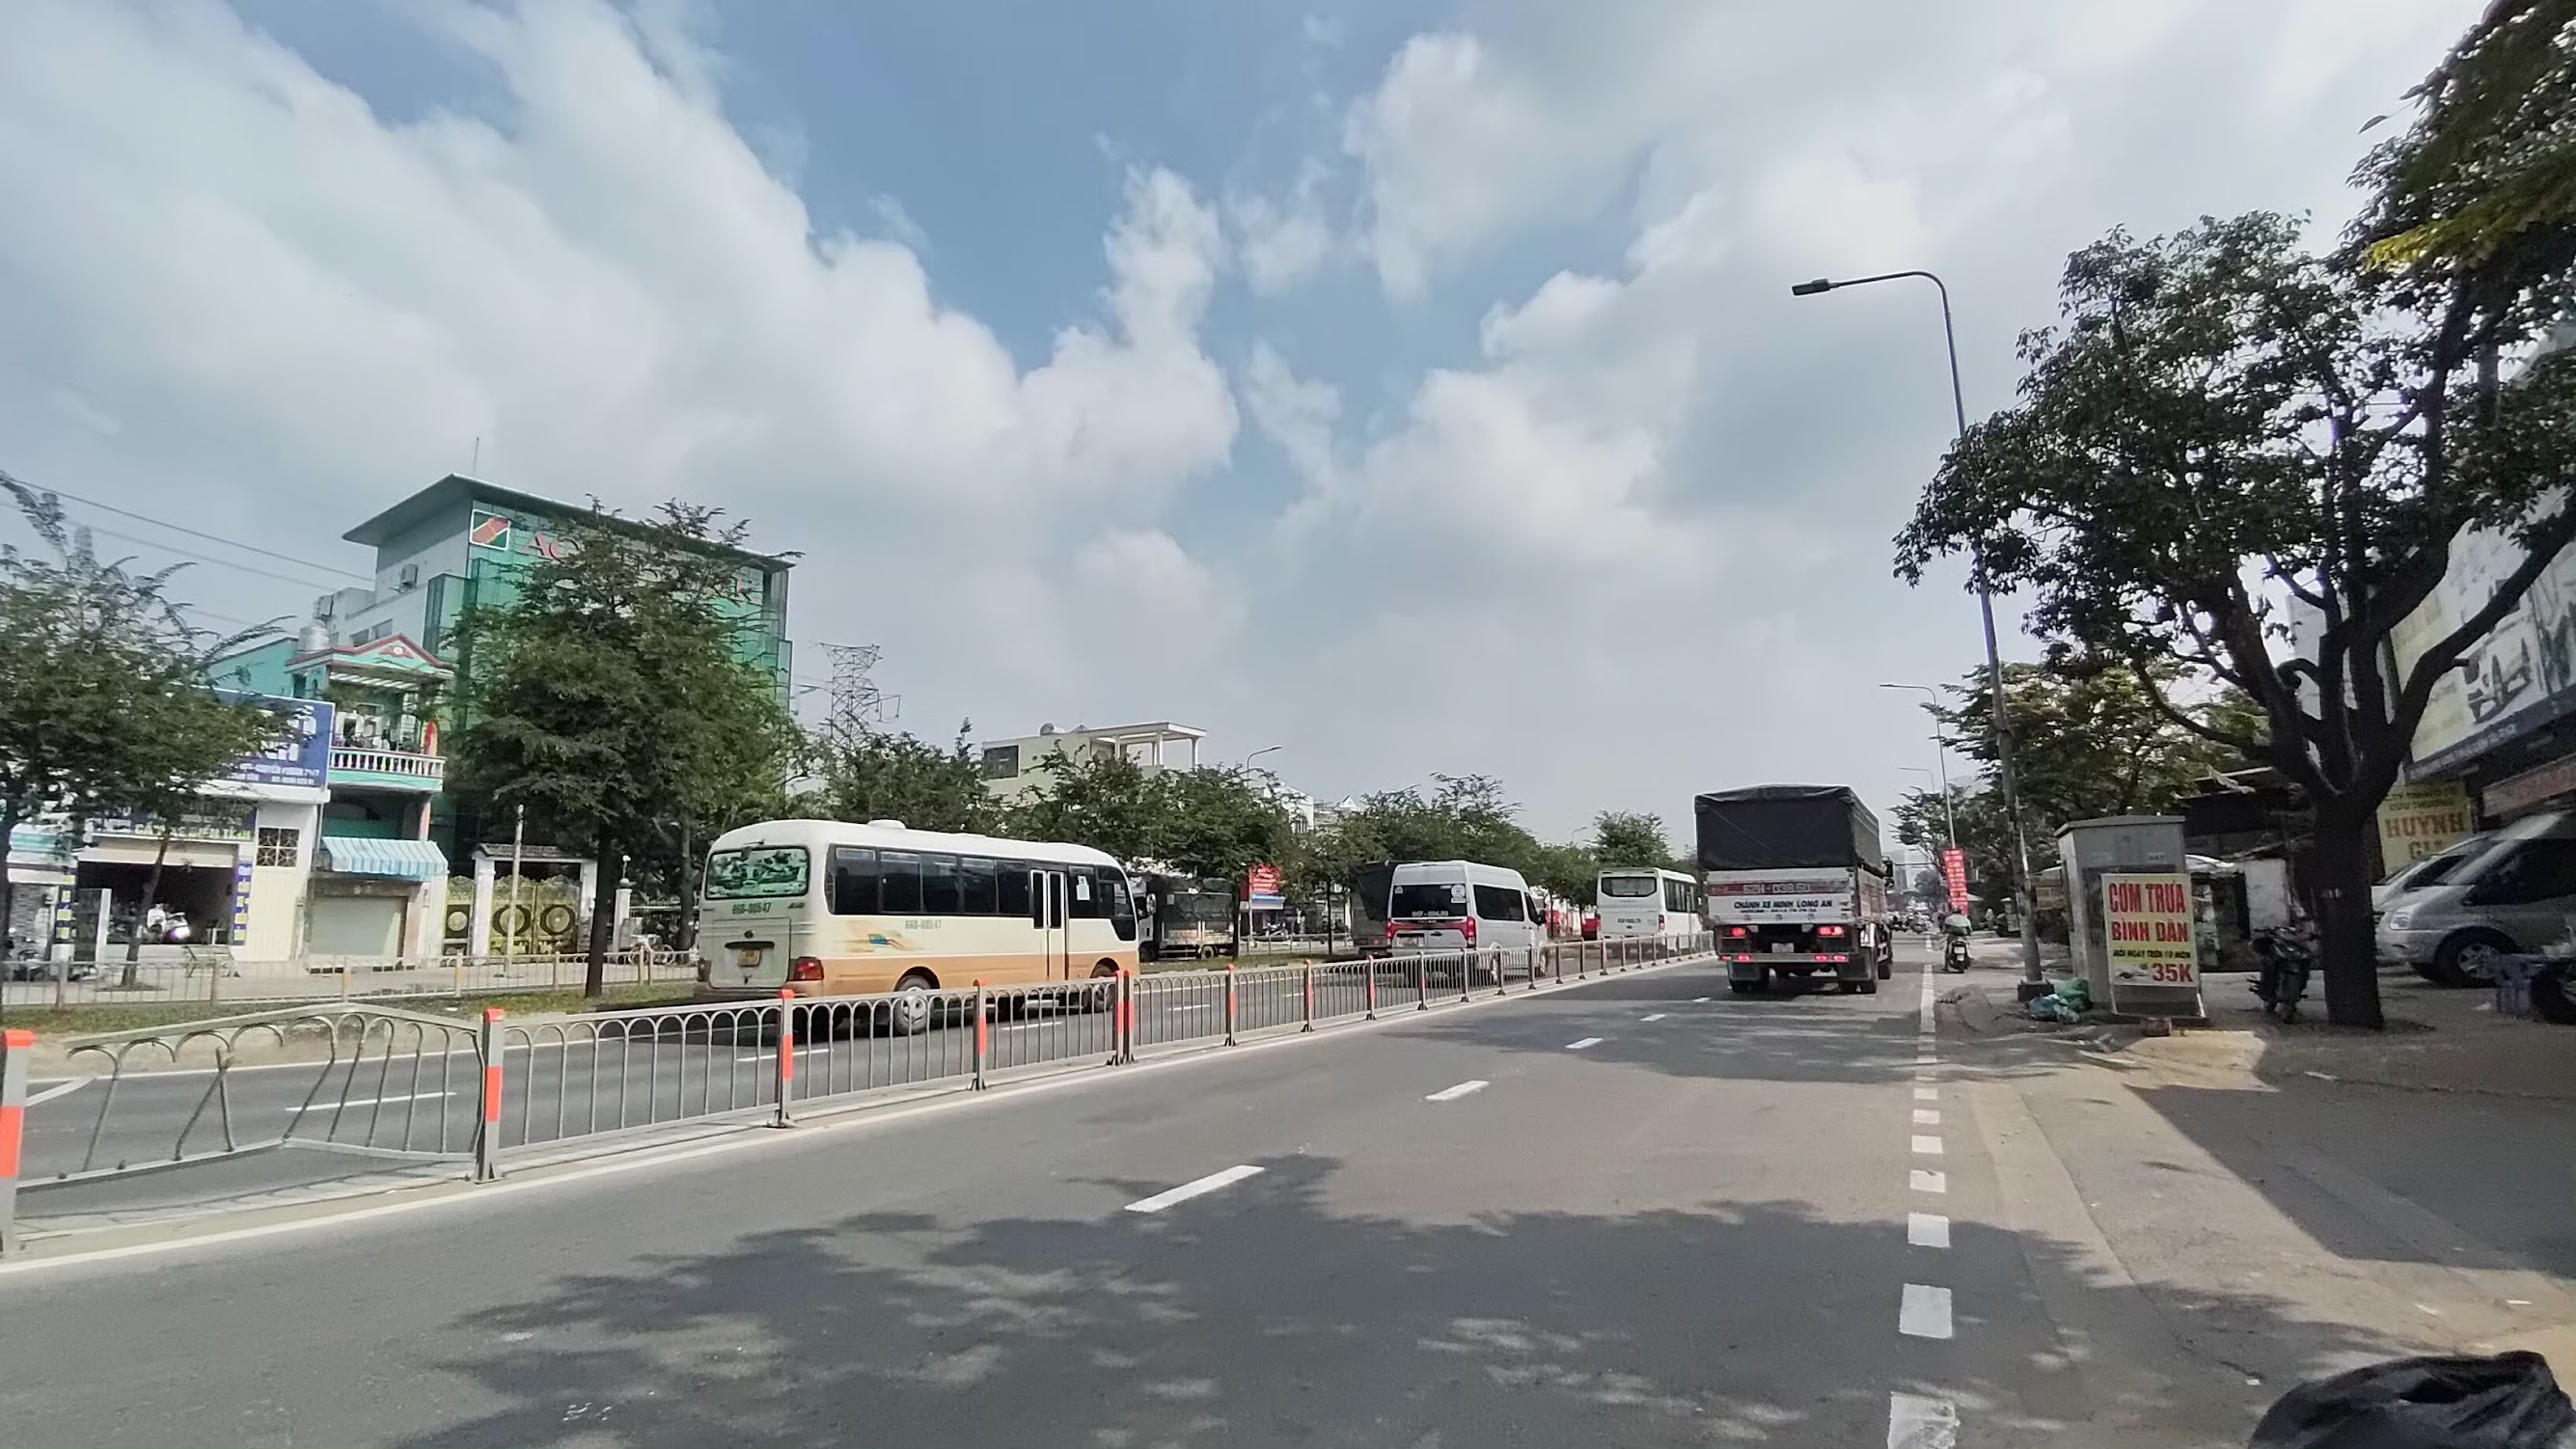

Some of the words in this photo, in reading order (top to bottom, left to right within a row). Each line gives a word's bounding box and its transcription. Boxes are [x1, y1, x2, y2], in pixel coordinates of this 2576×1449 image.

[1797, 898, 1819, 908] LONG
[1822, 898, 1832, 908] AN
[2111, 917, 2150, 942] BÌNH
[2155, 918, 2189, 943] DÂN
[2151, 963, 2193, 982] 35K
